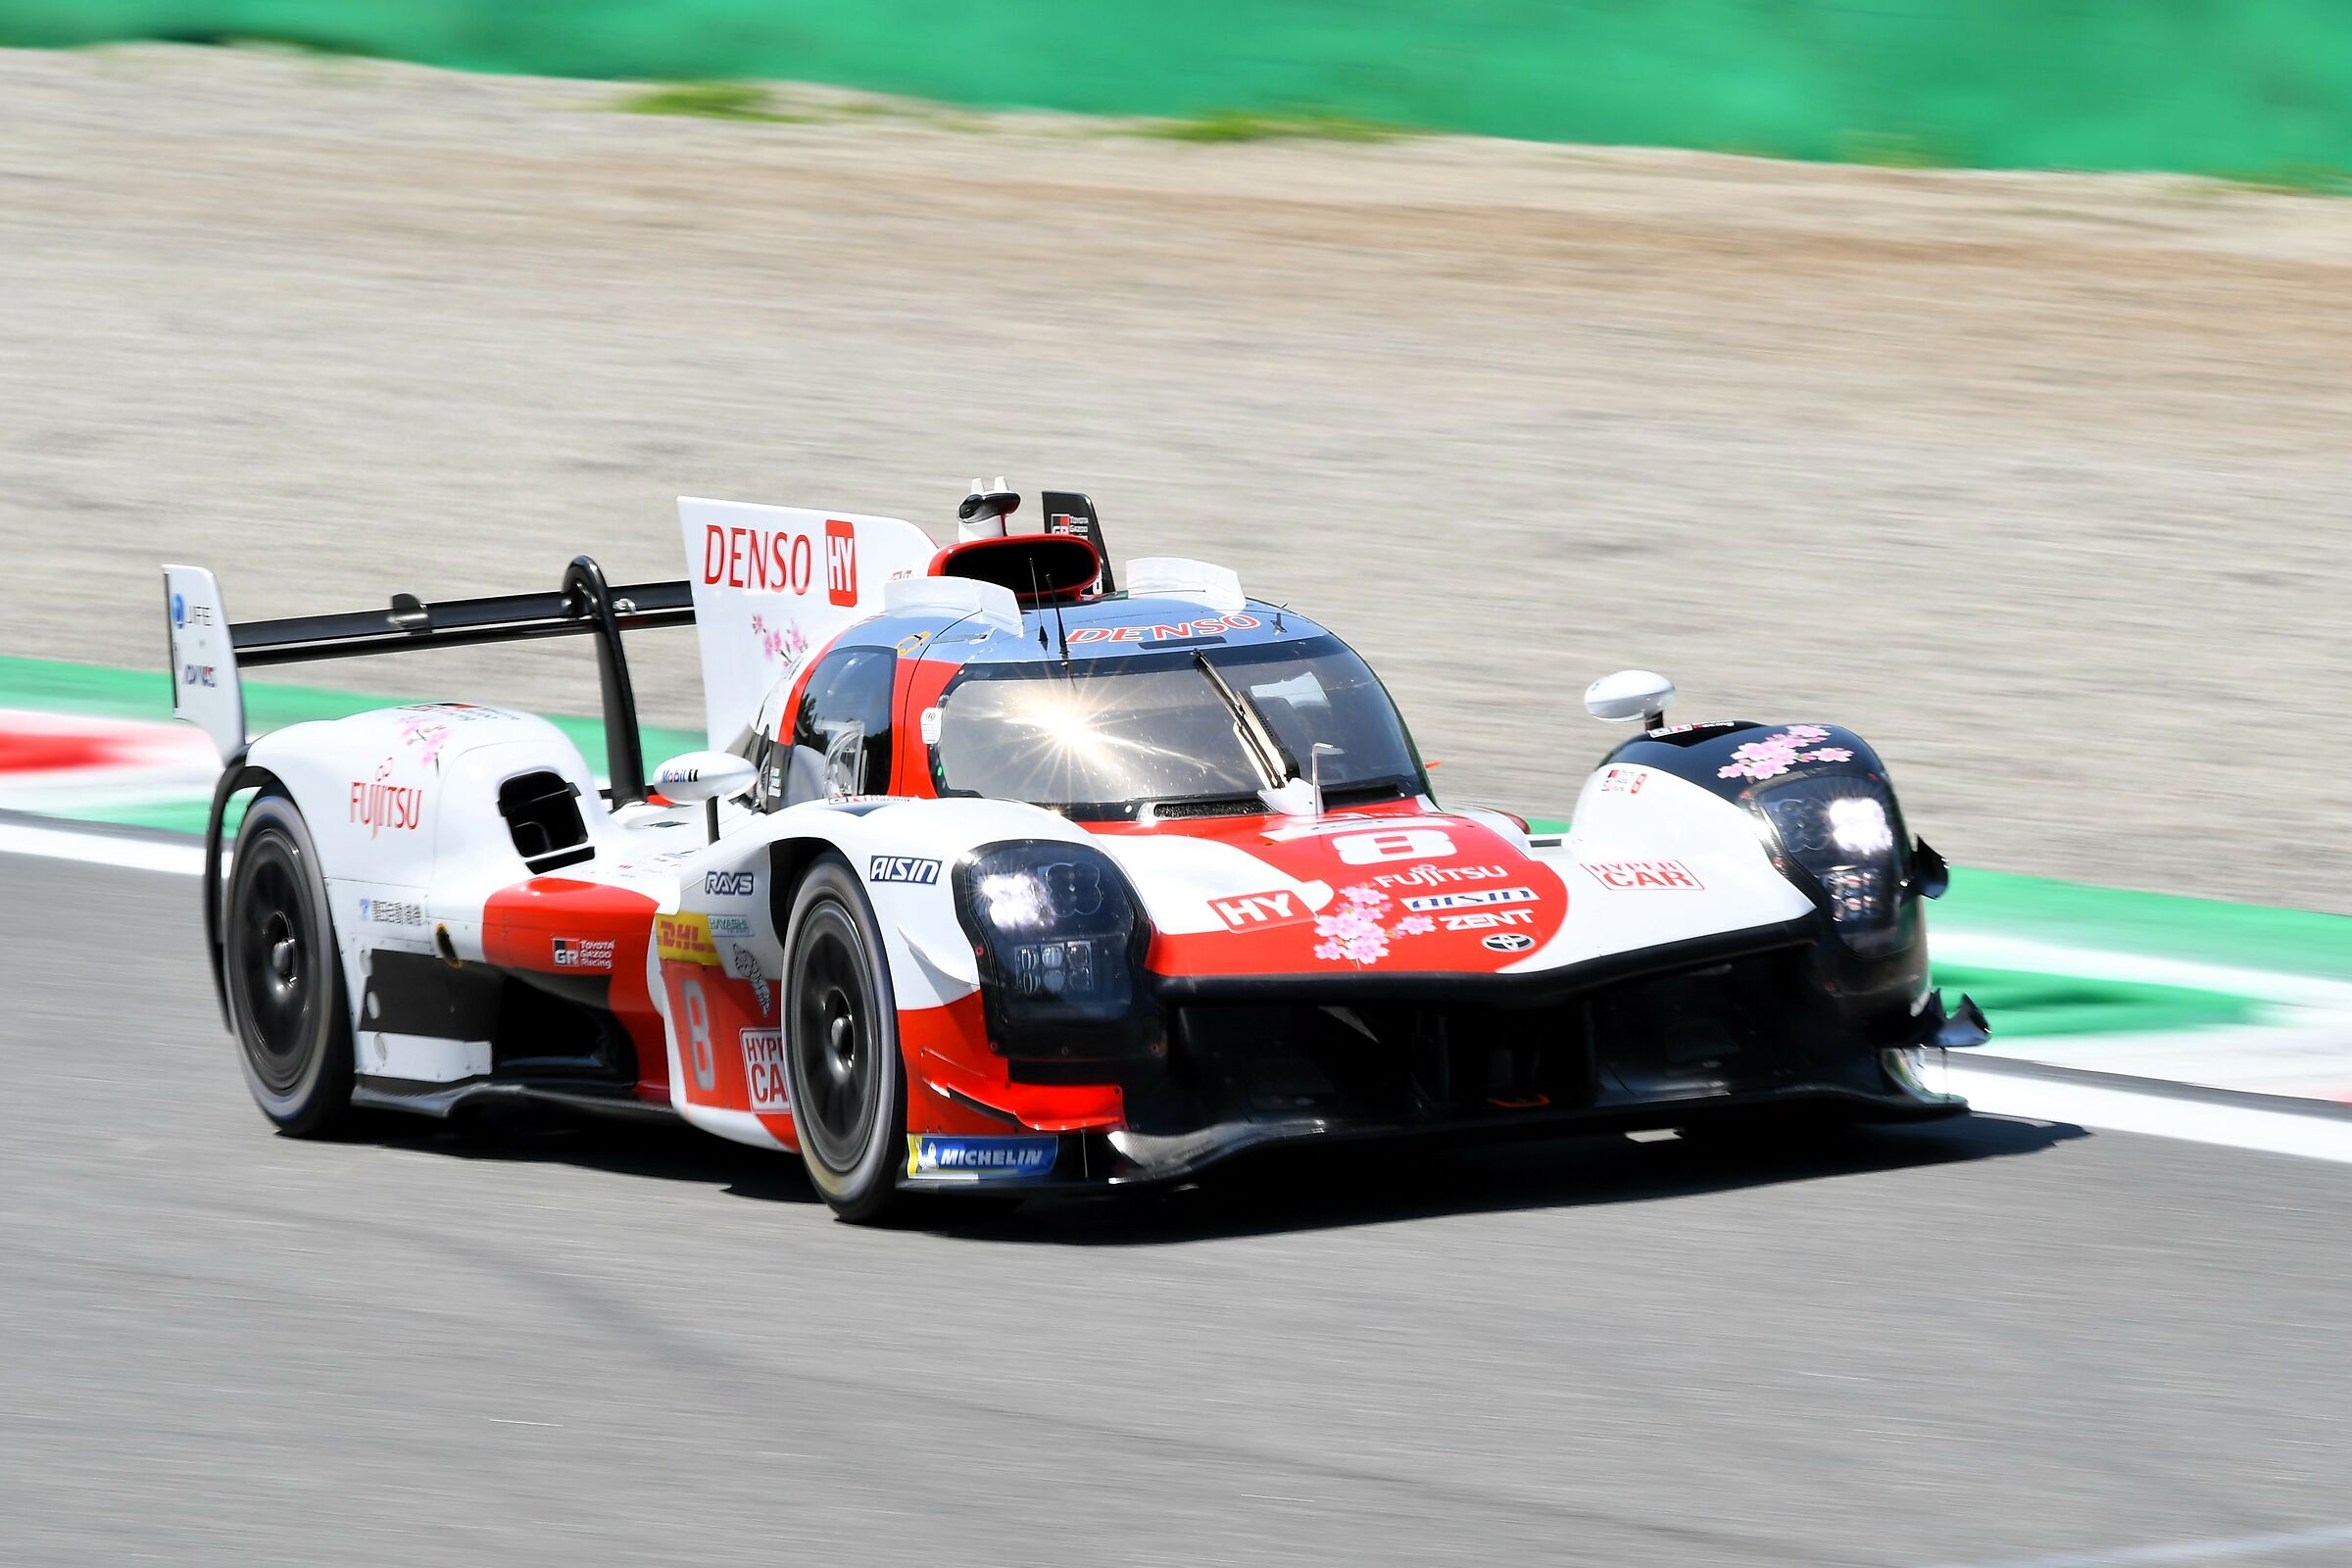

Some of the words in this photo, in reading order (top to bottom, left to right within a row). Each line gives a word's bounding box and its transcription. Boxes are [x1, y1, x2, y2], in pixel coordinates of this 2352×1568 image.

[704, 524, 811, 596] DENSO
[827, 536, 854, 592] HY
[1066, 613, 1261, 644] DENSO
[662, 768, 686, 784] Mobil
[349, 781, 423, 840] FUJITSU
[1332, 829, 1457, 865] 8
[705, 871, 754, 897] RAYS
[871, 857, 941, 884] AISIN
[1373, 864, 1509, 889] FUJITSU
[1602, 871, 1694, 887] CAR
[1218, 893, 1295, 926] HY
[1439, 907, 1535, 931] ZENT
[661, 919, 706, 952] DHL
[555, 949, 579, 965] GR
[681, 978, 716, 1092] 8
[747, 1036, 784, 1060] HYP
[751, 1063, 790, 1104] CA
[939, 1148, 1043, 1167] MICHELIN
